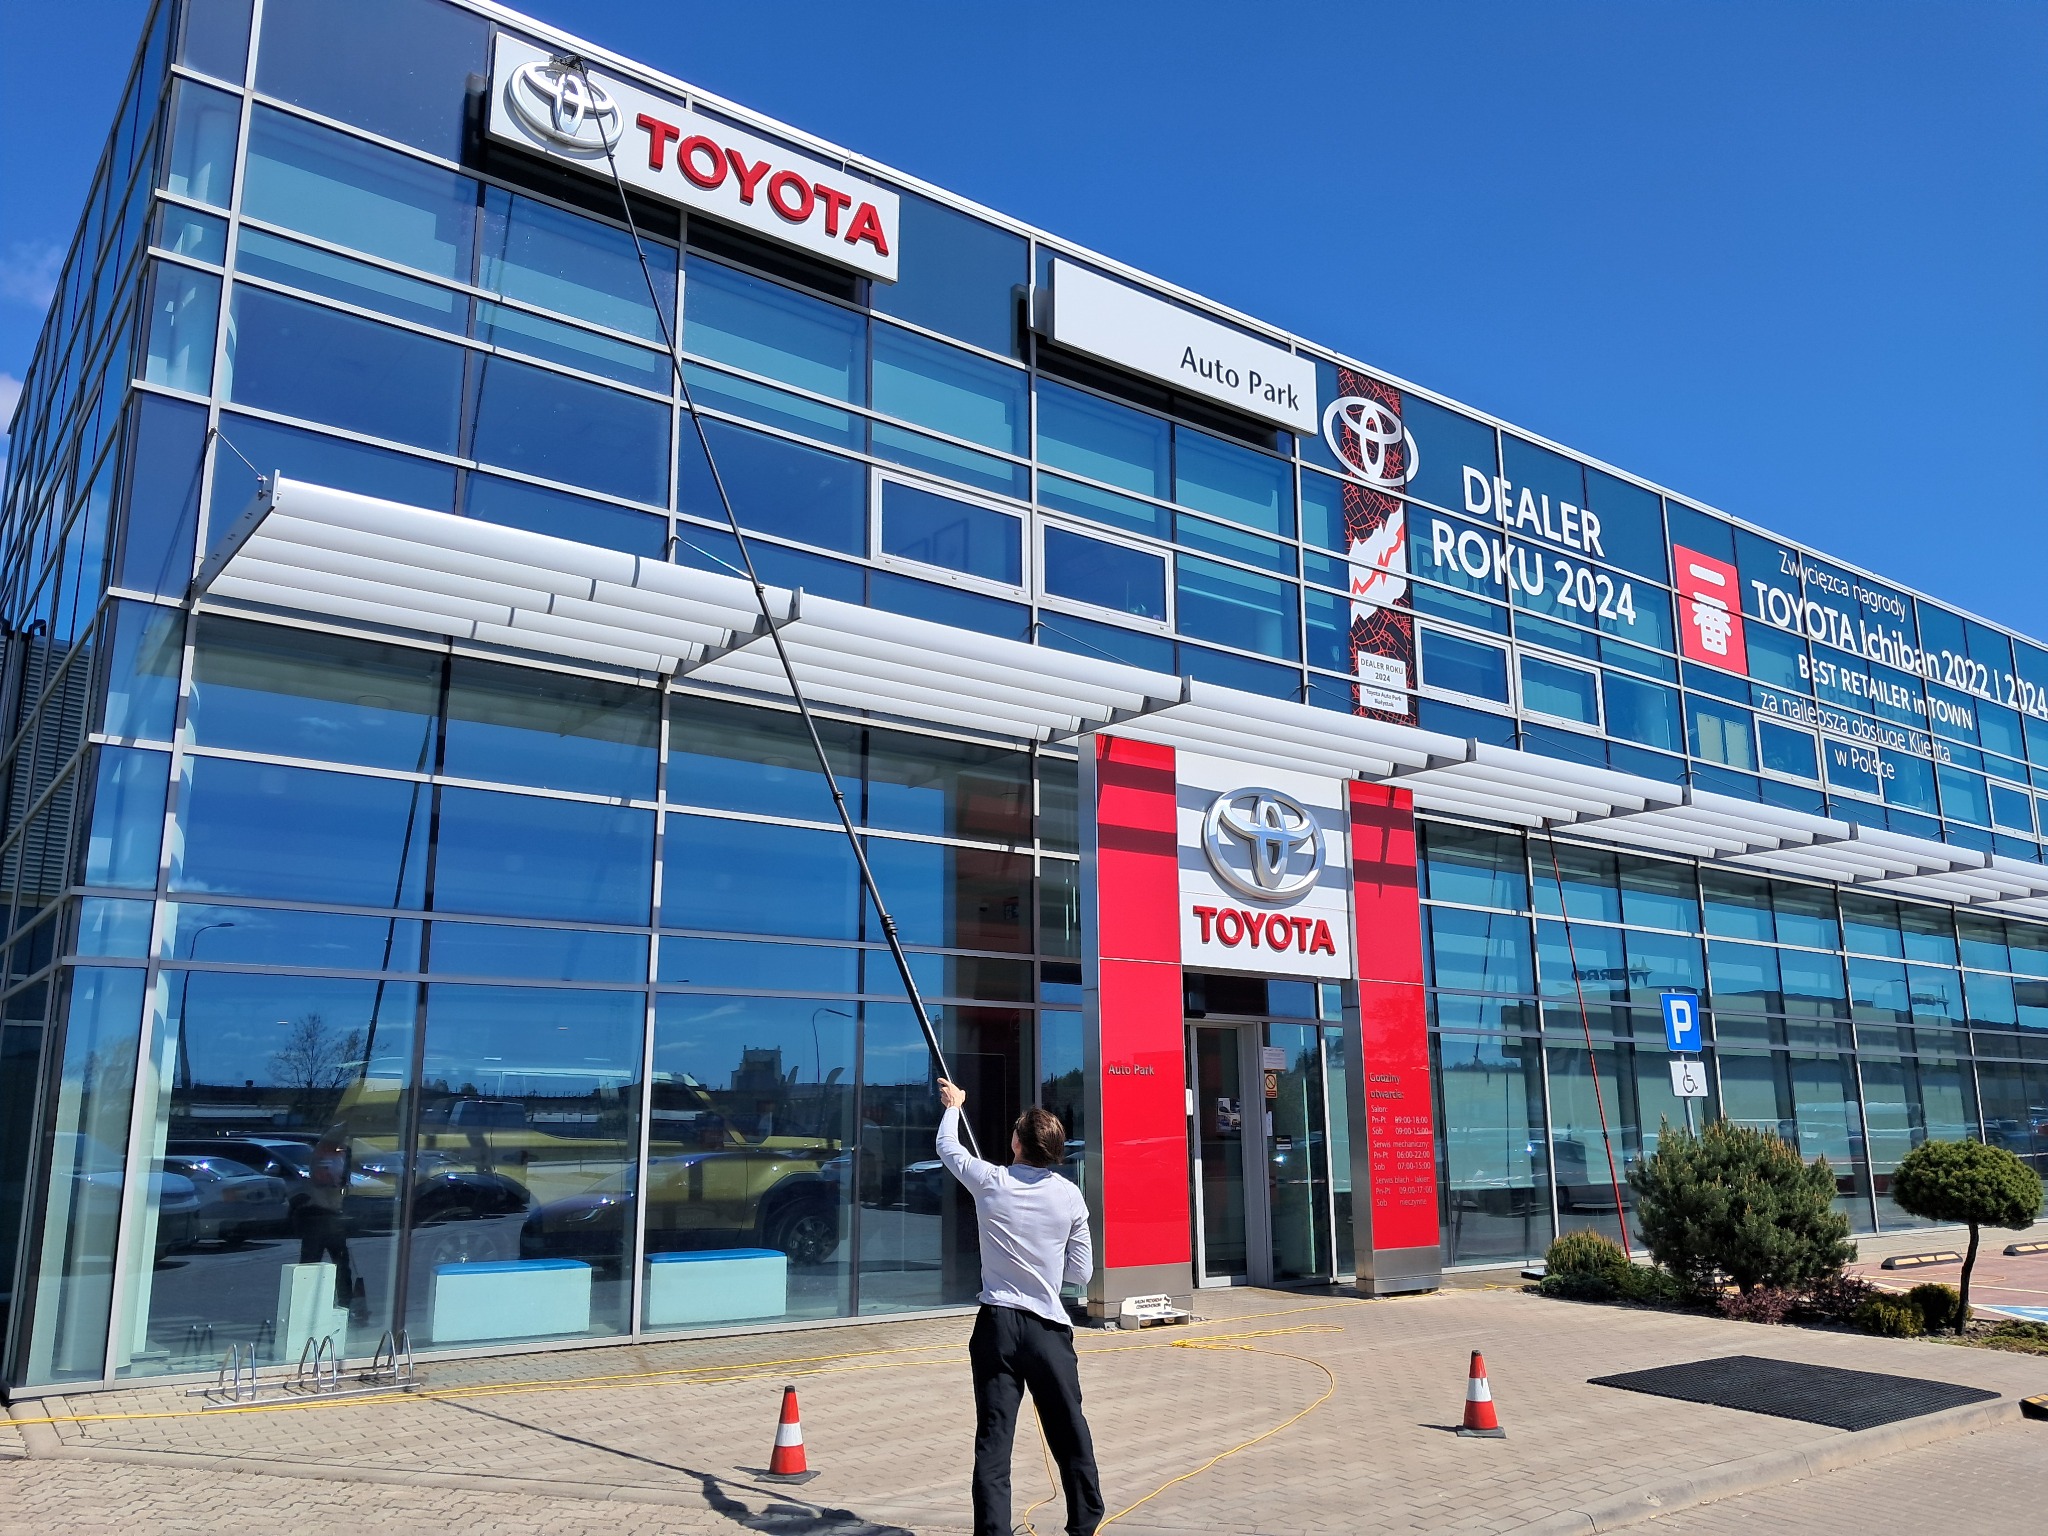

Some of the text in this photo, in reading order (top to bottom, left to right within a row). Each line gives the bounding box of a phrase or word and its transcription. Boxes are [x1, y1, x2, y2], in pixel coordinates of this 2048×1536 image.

[636, 112, 889, 257] TOYOTA
[1180, 346, 1299, 412] Auto Park
[1462, 465, 1605, 557] DEALER
[1431, 518, 1637, 626] ROKU 2024
[1778, 550, 1906, 623] Zwycięzca nagrody
[1361, 658, 1404, 674] DEALER ROKU
[1751, 579, 1858, 653] TOYOTA
[1860, 619, 1941, 680] Ichiban
[1942, 650, 1991, 699] 2022
[2004, 673, 2048, 719] 2024
[1366, 689, 1381, 697] Toyota
[1375, 672, 1391, 682] 2024
[1798, 654, 1973, 731] BEST RETAILER in TOWN
[1760, 692, 1778, 712] za
[1909, 730, 1951, 762] Klienta
[1835, 747, 1895, 780] w Polsce
[1193, 905, 1336, 956] TOYOTA
[1670, 999, 1693, 1043] P
[1108, 1064, 1155, 1076] Auto Park
[1373, 1140, 1391, 1148] Serwis
[1374, 1151, 1389, 1159] Pn-Pt
[1376, 1176, 1393, 1184] Serwis
